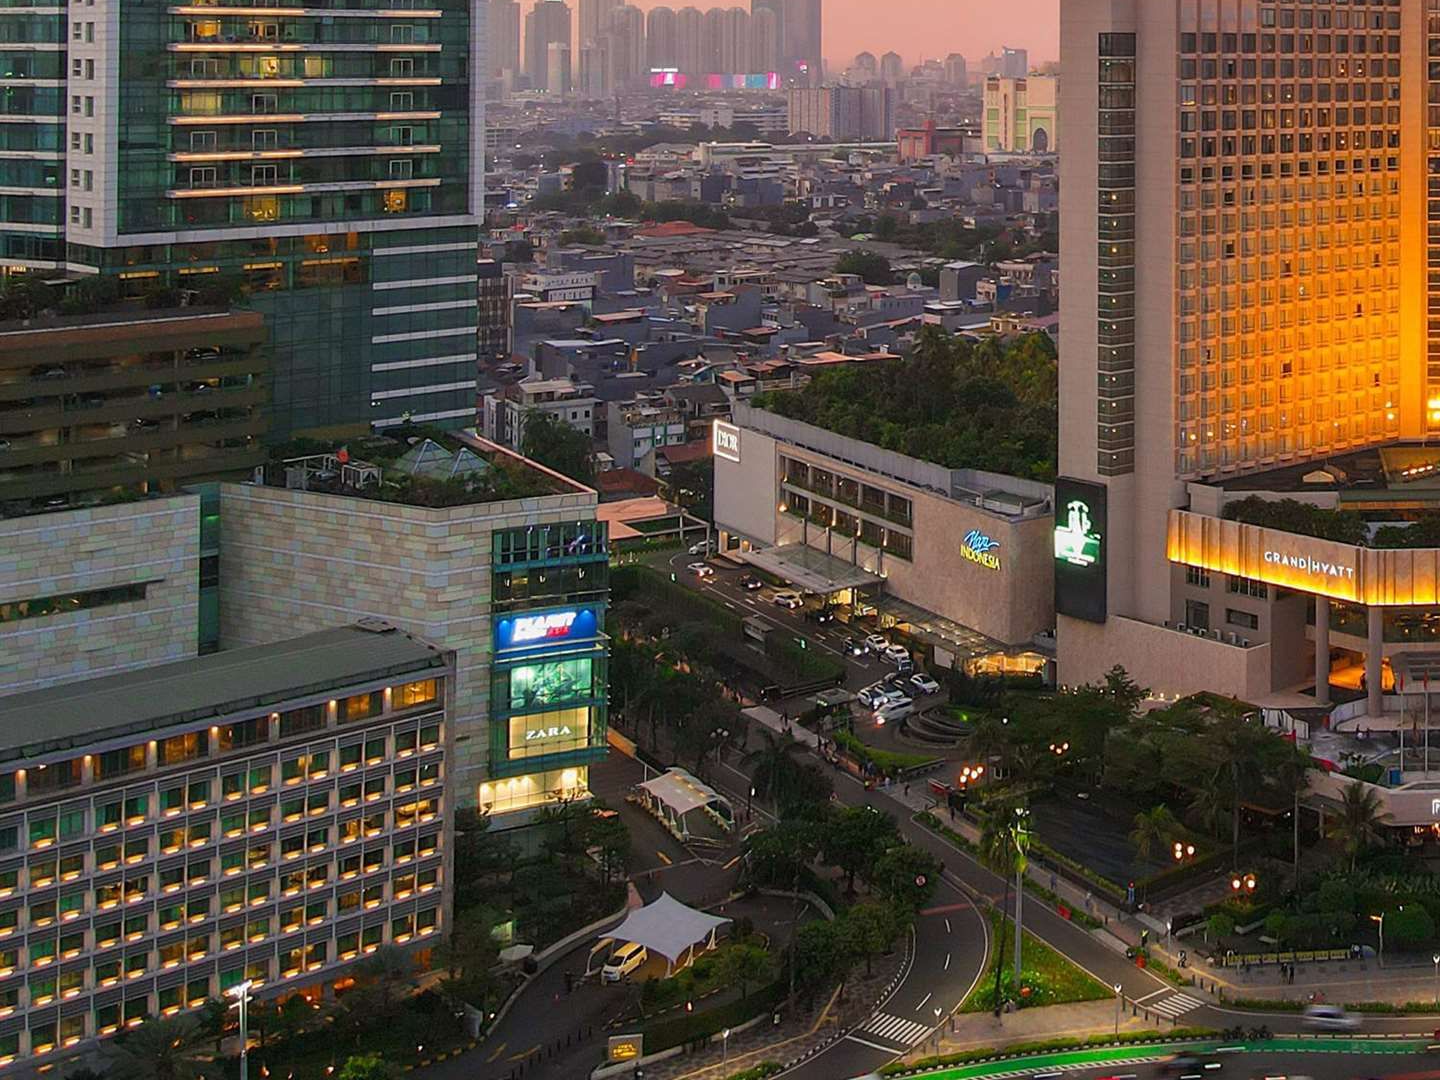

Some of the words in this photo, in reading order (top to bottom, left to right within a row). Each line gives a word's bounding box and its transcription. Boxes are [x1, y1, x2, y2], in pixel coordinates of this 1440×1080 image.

[718, 430, 738, 452] DIOR
[960, 544, 1001, 571] INDONESIA
[1264, 551, 1307, 569] GRAND
[1312, 560, 1353, 579] HYATT
[526, 725, 571, 740] ZARA
